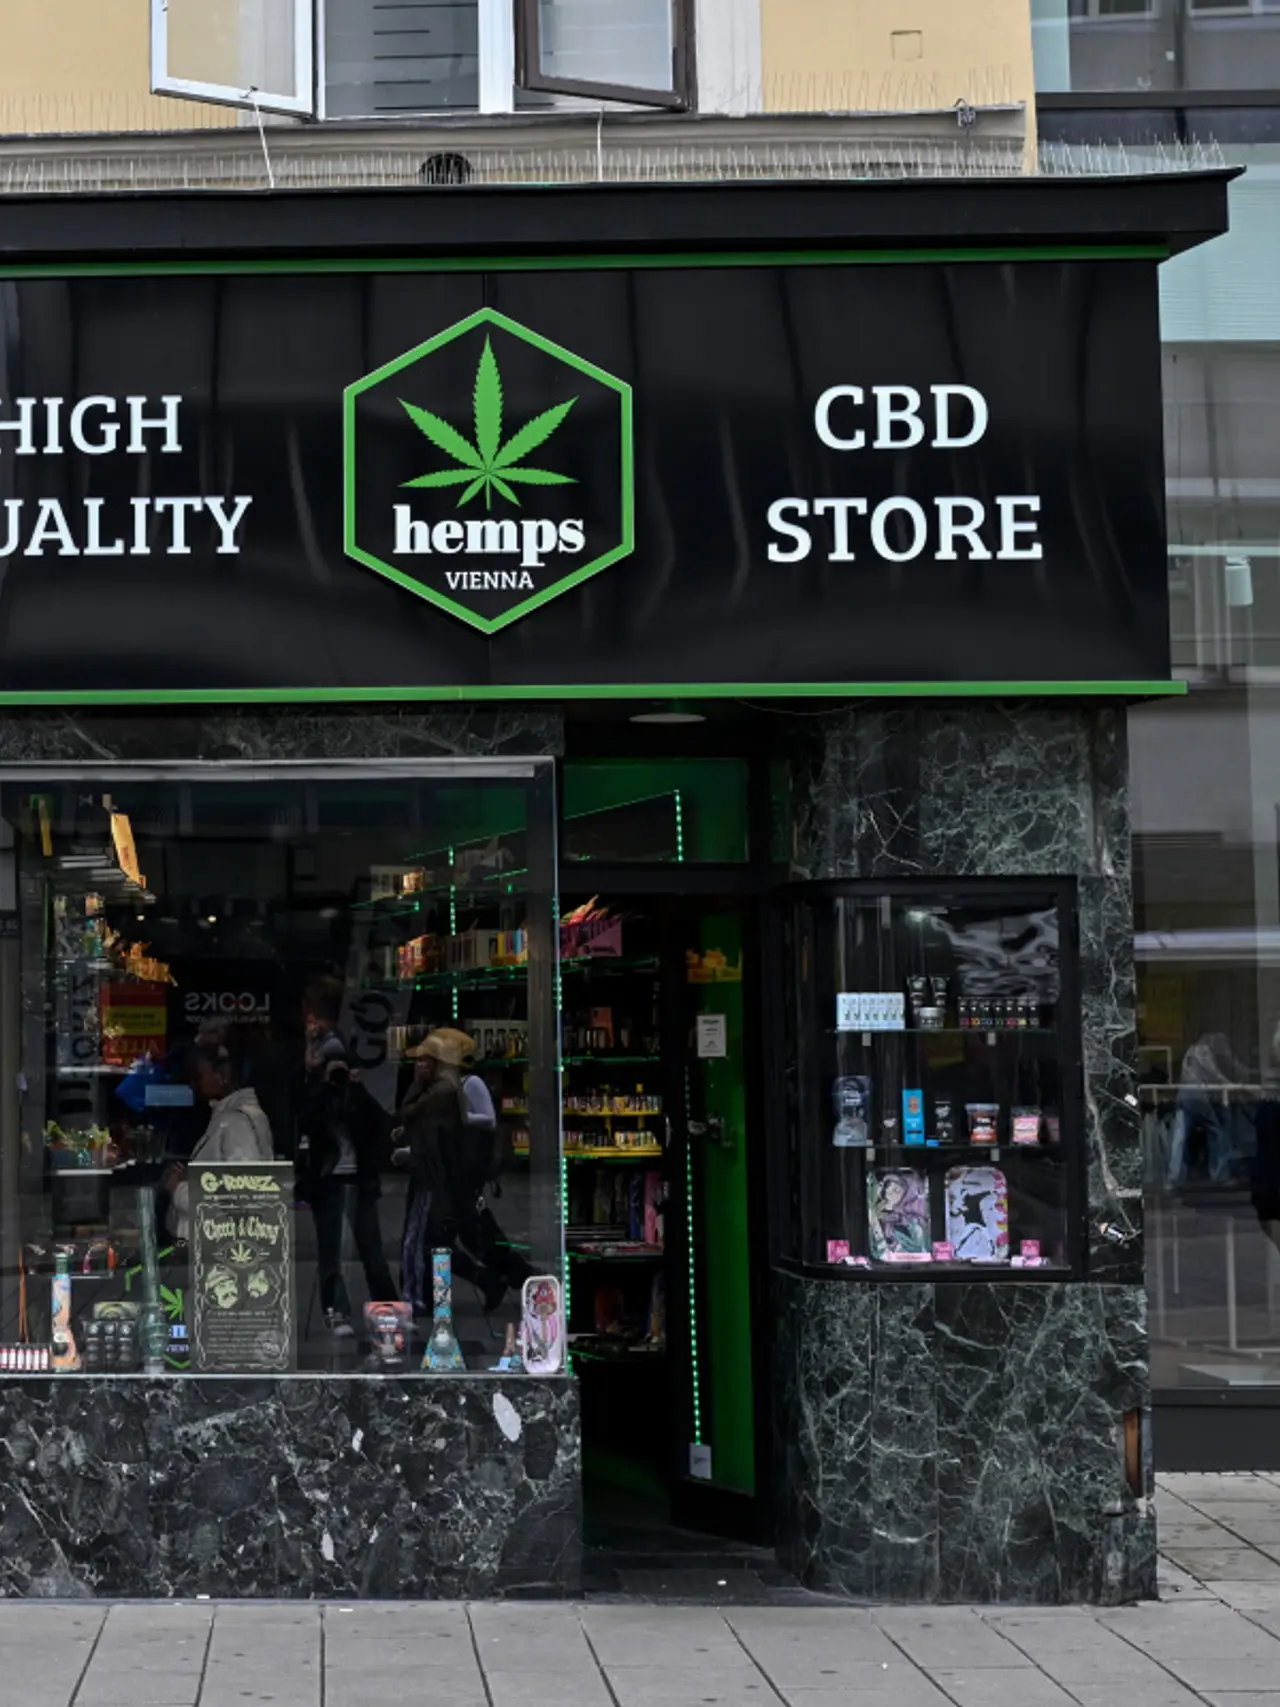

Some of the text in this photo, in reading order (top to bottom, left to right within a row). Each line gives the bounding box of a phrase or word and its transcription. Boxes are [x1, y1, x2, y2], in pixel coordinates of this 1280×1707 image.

[814, 384, 989, 450] CBD
[392, 505, 586, 567] hemps
[766, 494, 1043, 562] STORE
[445, 569, 535, 590] VIENNA
